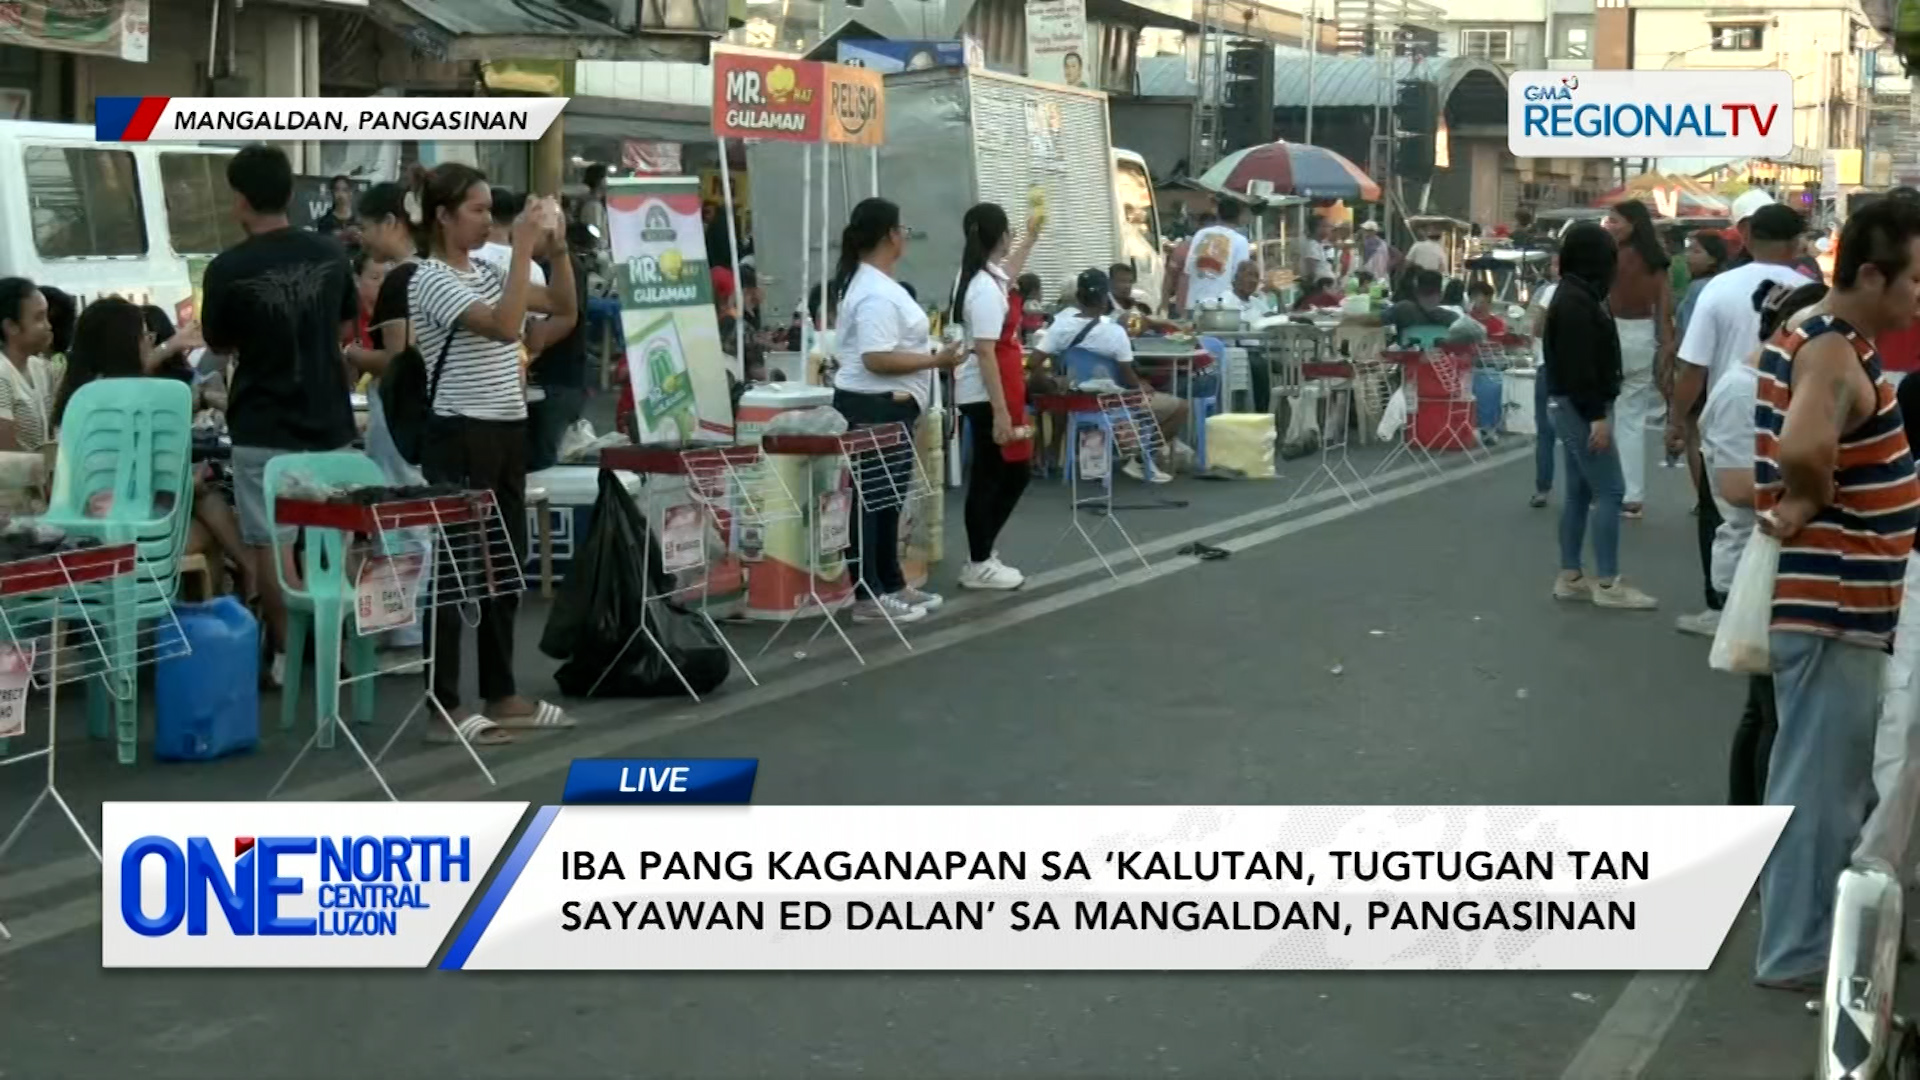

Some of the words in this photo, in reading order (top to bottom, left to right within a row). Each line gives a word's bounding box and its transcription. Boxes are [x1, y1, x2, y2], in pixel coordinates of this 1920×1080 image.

[726, 70, 766, 104] MR.
[725, 109, 806, 131] GULAMAN
[628, 256, 663, 284] MR.
[633, 284, 698, 303] GULAMAN
